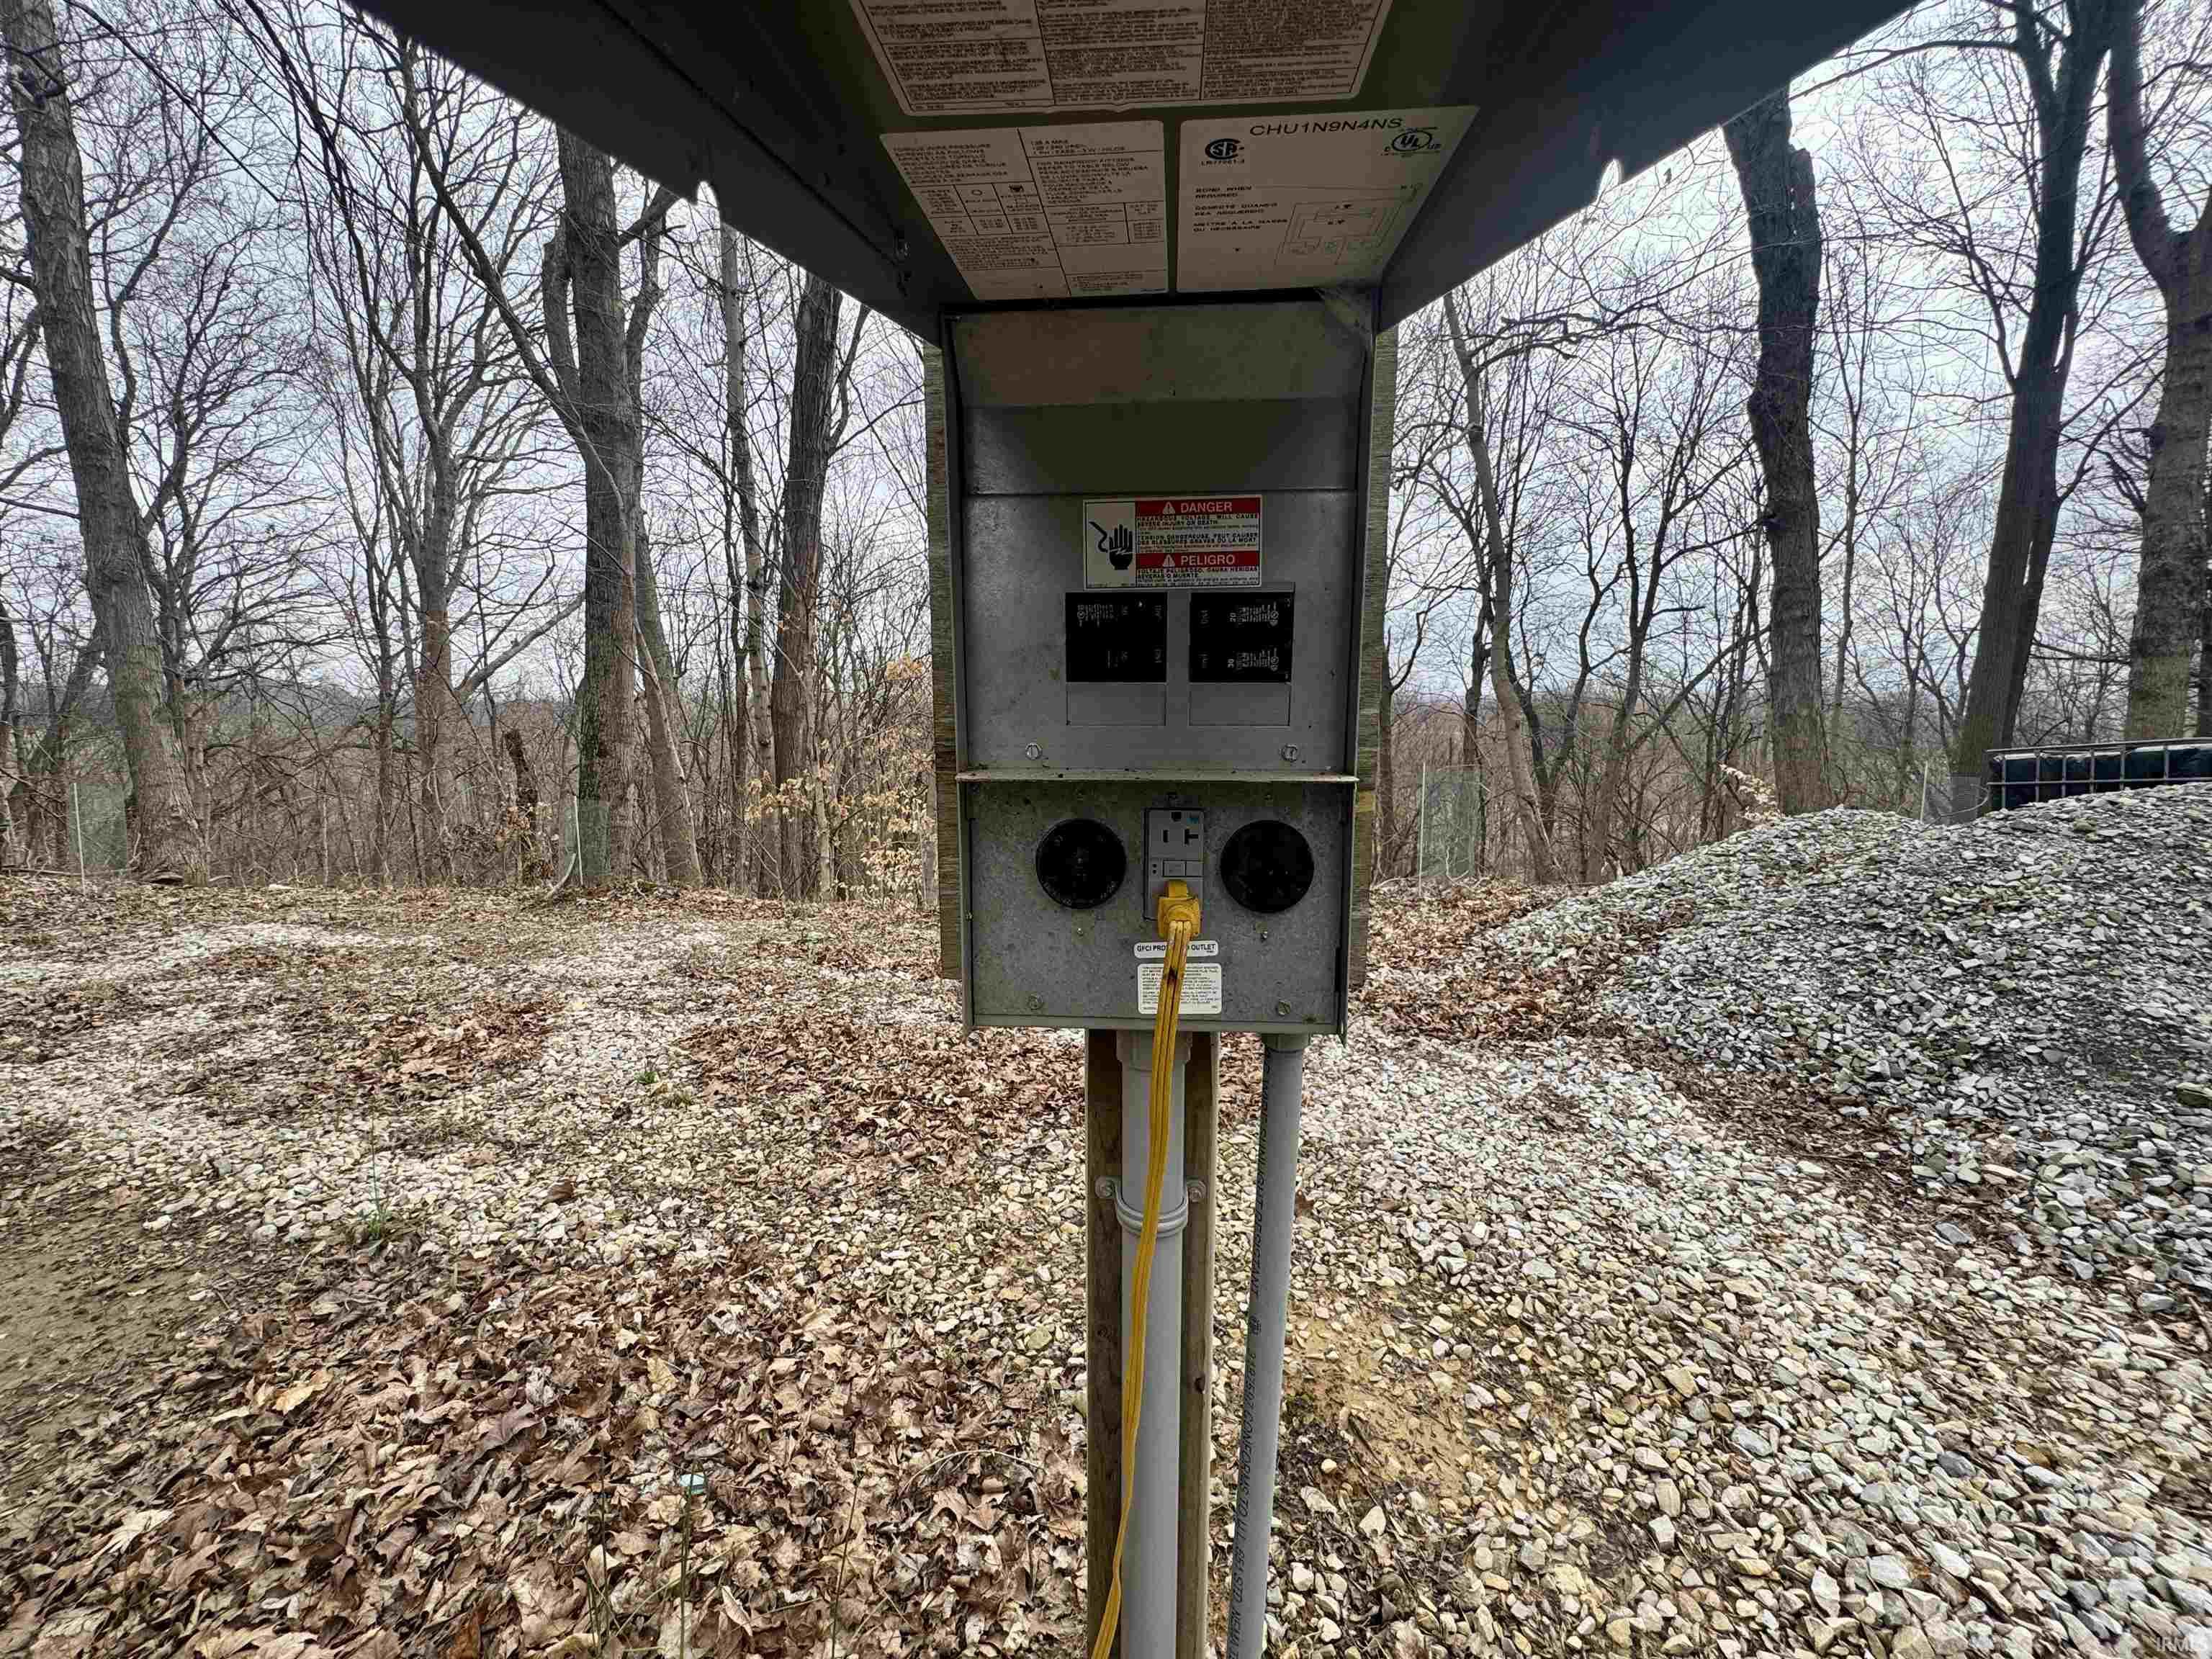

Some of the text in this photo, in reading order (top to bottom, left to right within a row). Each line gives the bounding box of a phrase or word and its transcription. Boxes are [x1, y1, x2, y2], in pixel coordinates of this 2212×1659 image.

[1249, 117, 1403, 136] CHU1N9N4NS
[1180, 501, 1233, 513] DANGER
[1180, 554, 1236, 566] PELIGRO
